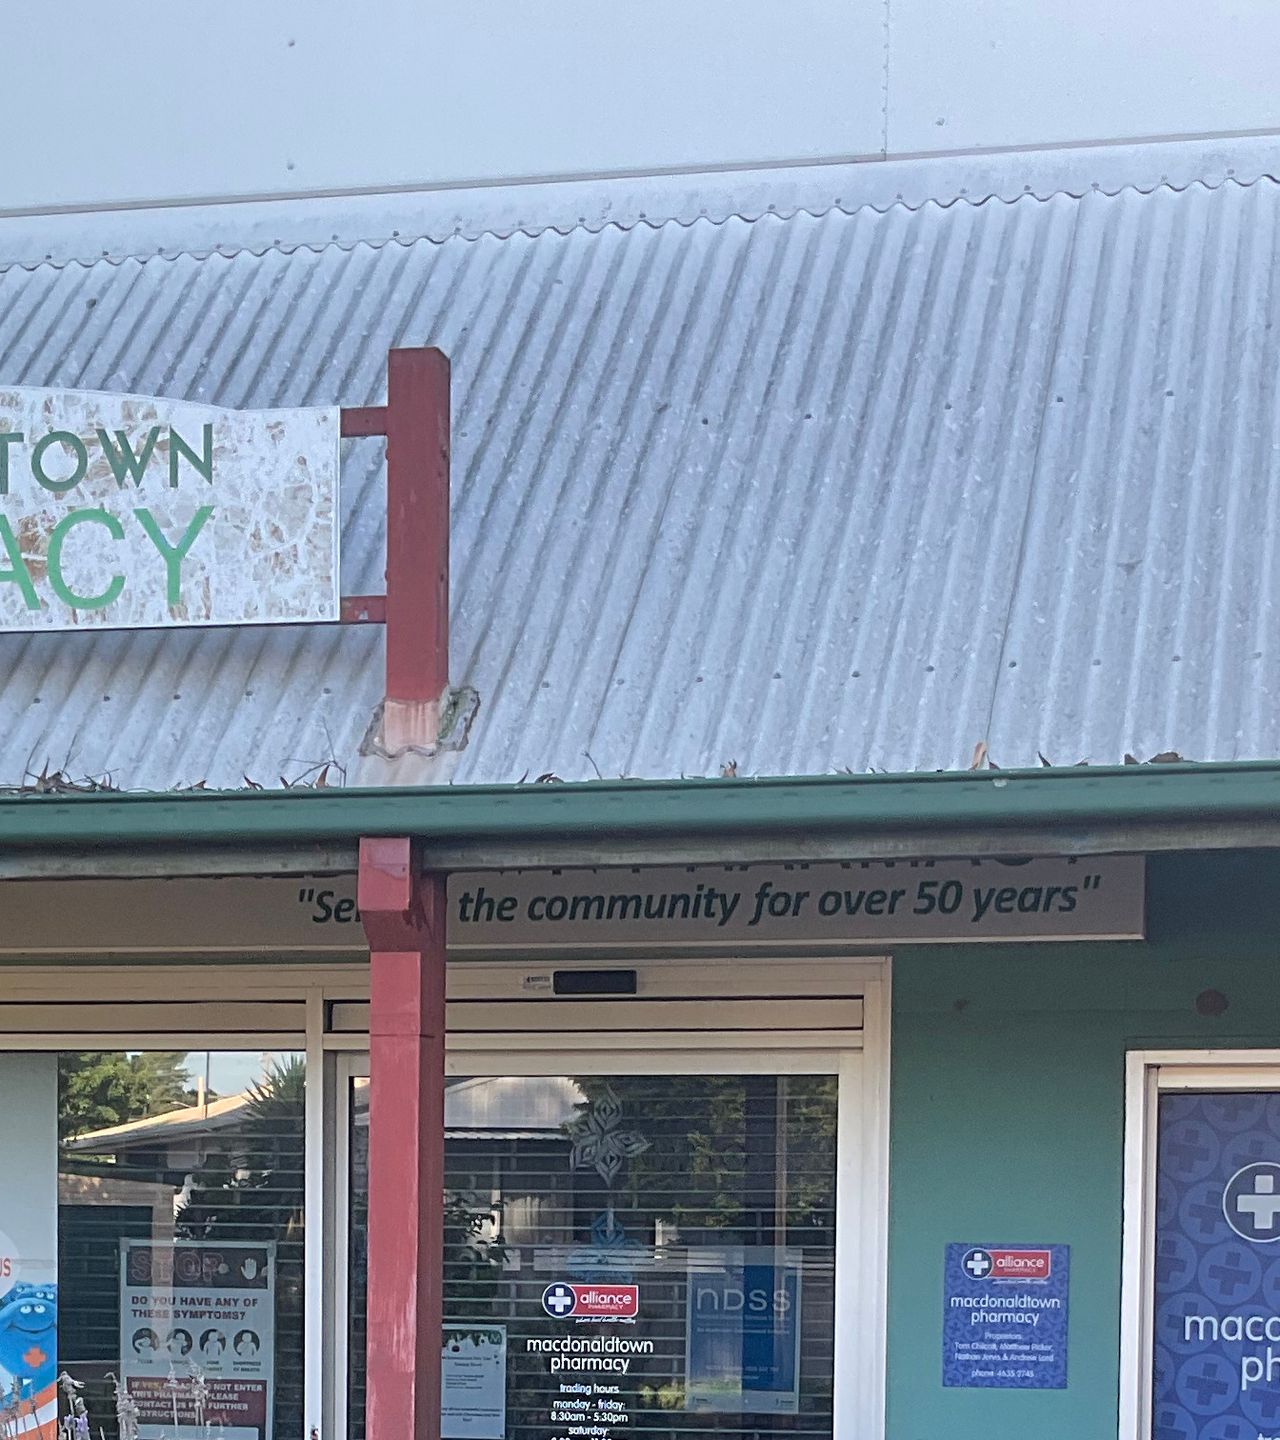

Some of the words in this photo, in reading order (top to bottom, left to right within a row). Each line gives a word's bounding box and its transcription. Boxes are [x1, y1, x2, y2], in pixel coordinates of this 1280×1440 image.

[458, 887, 517, 923] the
[526, 880, 740, 927] community
[748, 880, 807, 925] for
[819, 884, 905, 918] over
[913, 880, 962, 916] 50
[971, 875, 1102, 924] years"
[996, 1255, 1045, 1268] alliance
[132, 1296, 148, 1305] DO
[152, 1296, 176, 1306] YOU
[181, 1297, 211, 1307] HAVE
[215, 1298, 240, 1307] ANY
[243, 1298, 259, 1307] OF
[580, 1290, 632, 1305] alliance
[950, 1294, 1061, 1309] macdonaldtown
[131, 1308, 170, 1319] THESE
[173, 1310, 247, 1321] SYMPTOMS?
[971, 1309, 1040, 1327] pharmacy
[526, 1335, 654, 1354] macdonaldtown
[550, 1354, 630, 1375] pharmacy
[560, 1383, 592, 1396] trading
[593, 1383, 620, 1394] hours
[553, 1399, 591, 1411] monday
